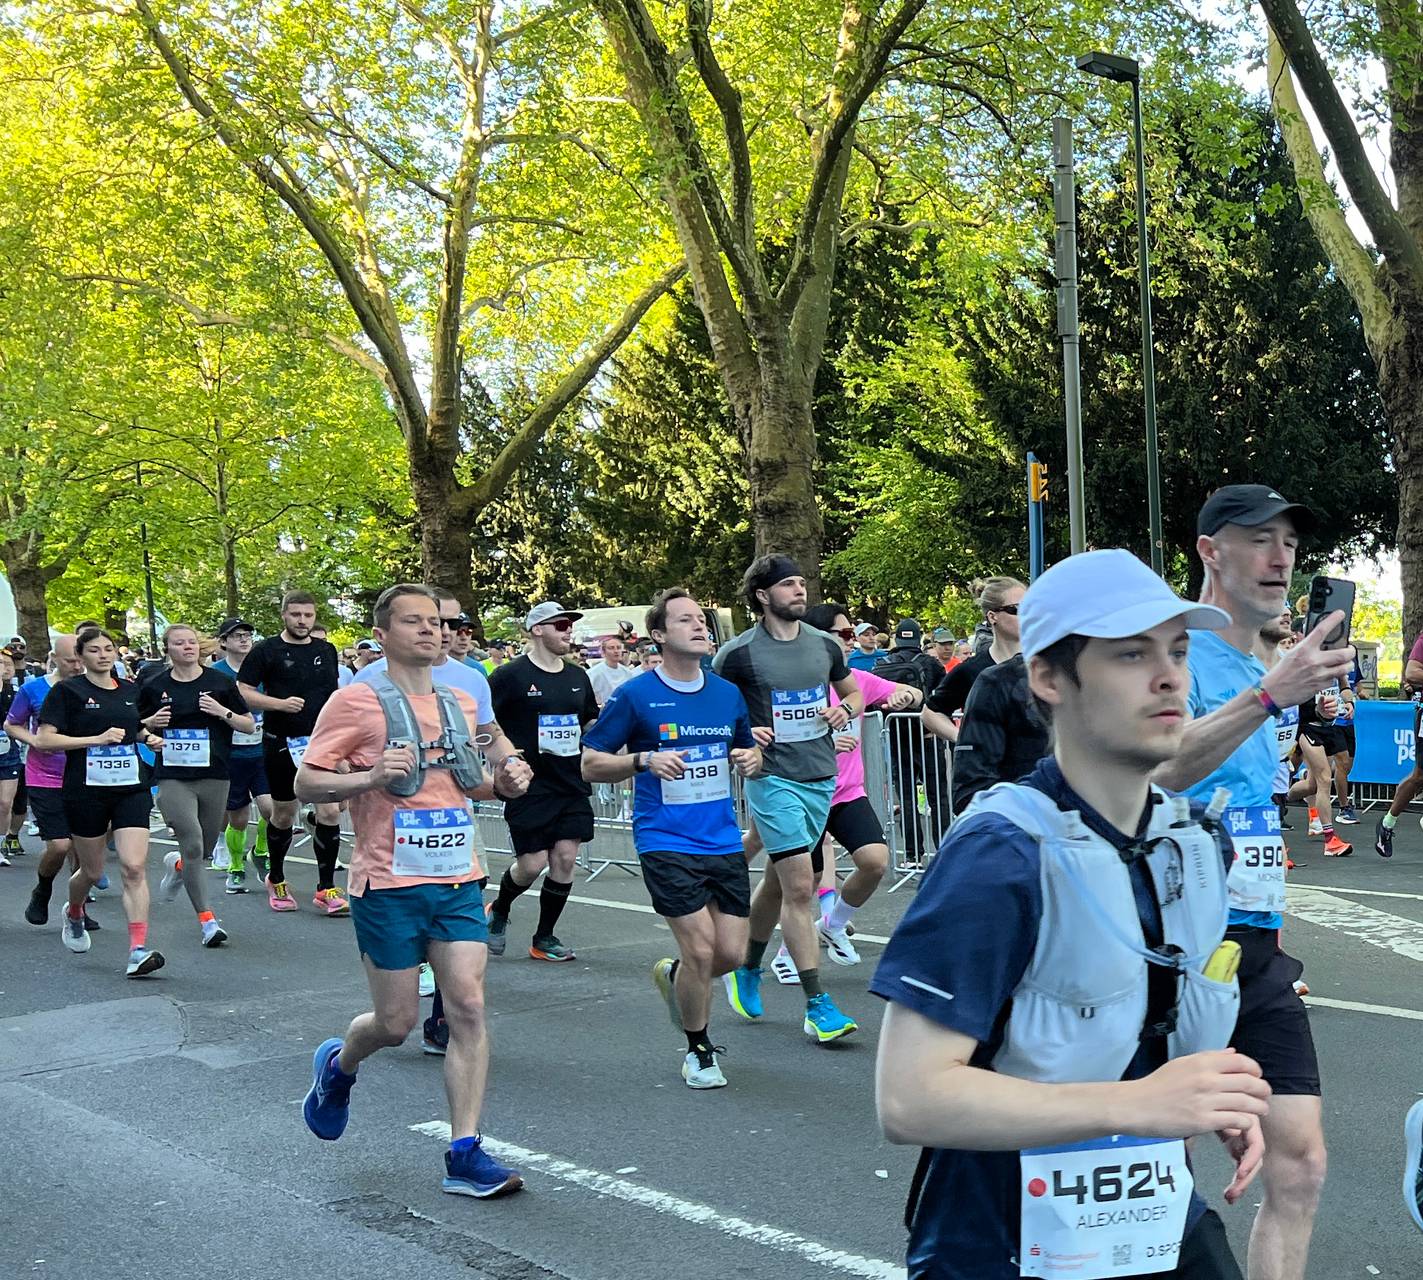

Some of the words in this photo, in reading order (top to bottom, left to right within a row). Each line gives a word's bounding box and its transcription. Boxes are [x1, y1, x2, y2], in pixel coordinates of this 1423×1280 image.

[680, 725, 732, 737] Microsoft
[1275, 730, 1293, 741] 65
[1394, 729, 1416, 745] un
[170, 742, 200, 751] 1378
[1398, 745, 1416, 765] pe
[96, 760, 131, 769] 1336
[1229, 808, 1247, 821] uni
[1262, 806, 1280, 820] uni
[1232, 820, 1253, 833] per
[1266, 820, 1281, 832] pe
[408, 832, 466, 848] 4622
[1052, 1161, 1176, 1205] 4624
[1076, 1205, 1168, 1229] ALEXANDER
